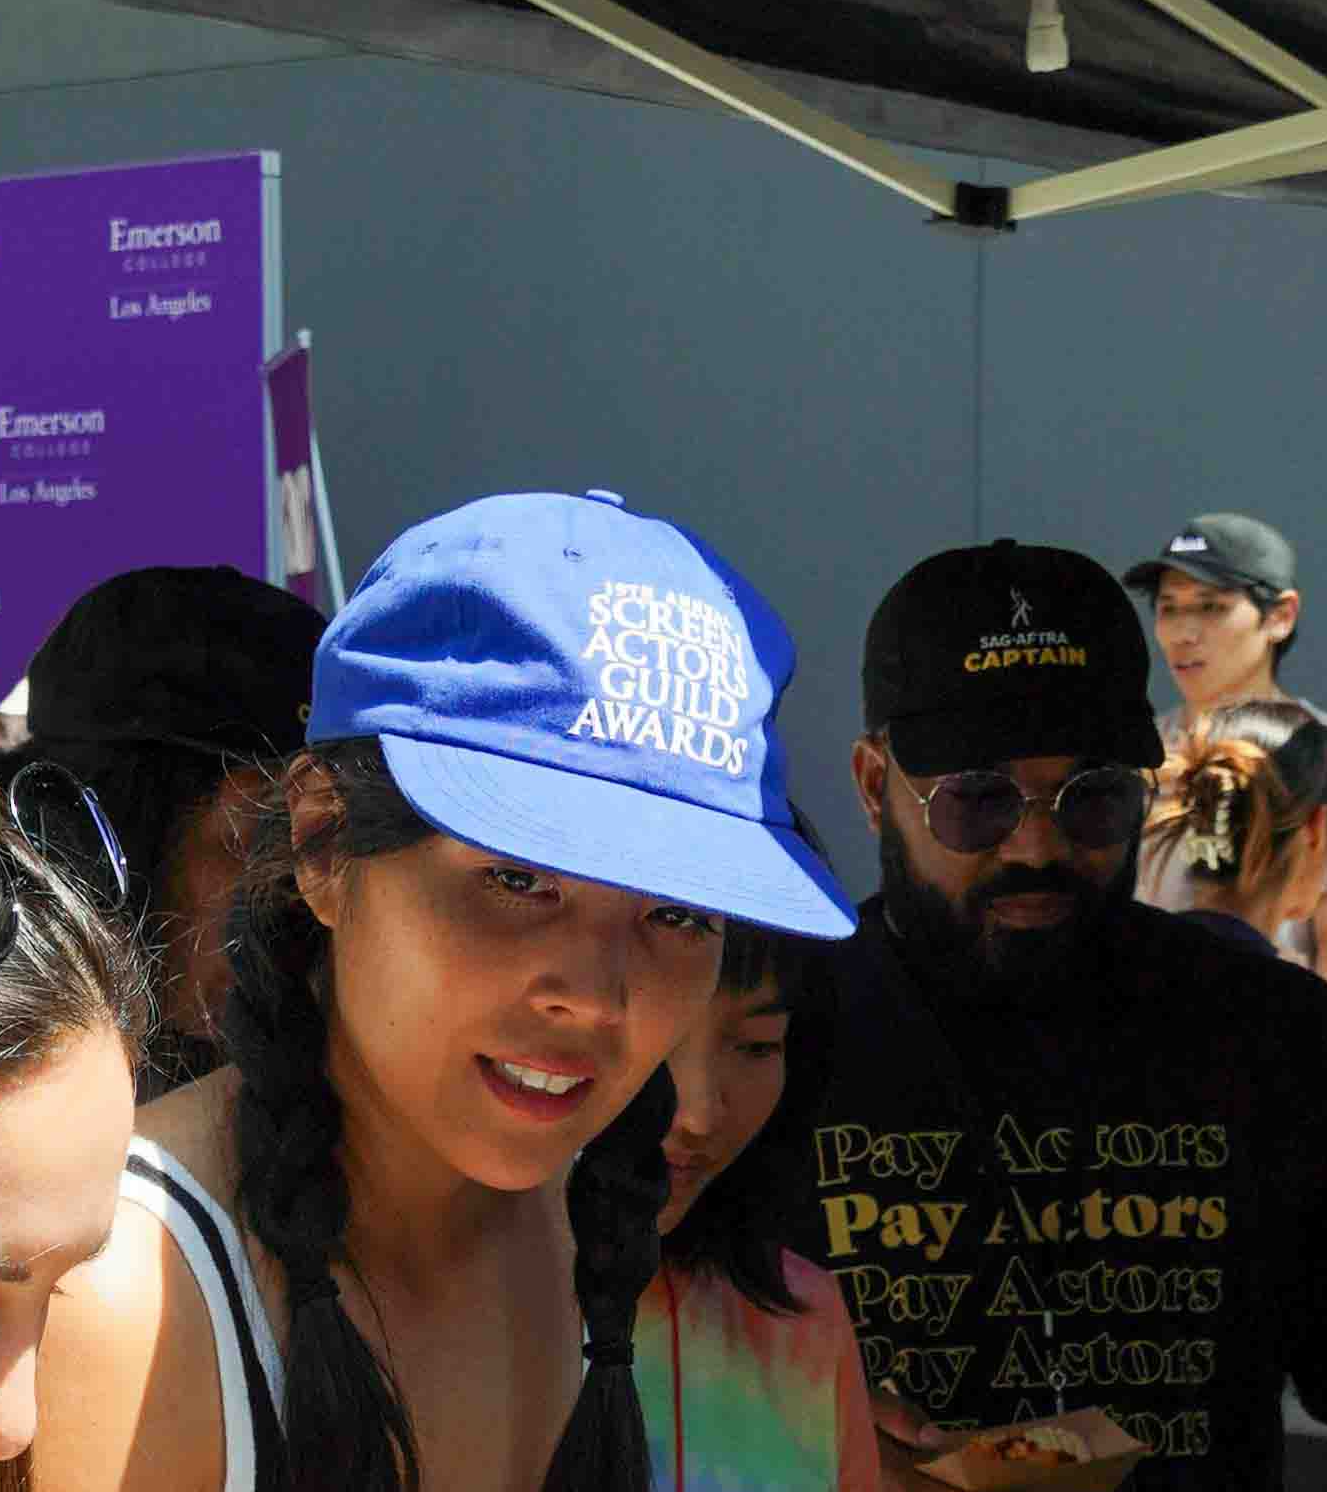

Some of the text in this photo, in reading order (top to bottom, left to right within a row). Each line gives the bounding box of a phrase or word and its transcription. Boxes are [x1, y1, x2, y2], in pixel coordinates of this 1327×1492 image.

[110, 218, 222, 252] Emerson
[109, 291, 213, 322] Los Angeles
[0, 479, 97, 508] Los Angeles
[588, 593, 743, 663] SCREEN
[963, 646, 1088, 674] CAPTAIN
[582, 625, 749, 700] ACTORS
[600, 662, 740, 729] GUILD
[567, 698, 748, 776] AWARDS
[814, 1123, 962, 1190] Pay
[821, 1188, 1229, 1261] Pay Actors
[834, 1255, 1224, 1336] Pay Actors
[990, 1326, 1218, 1388] Actors
